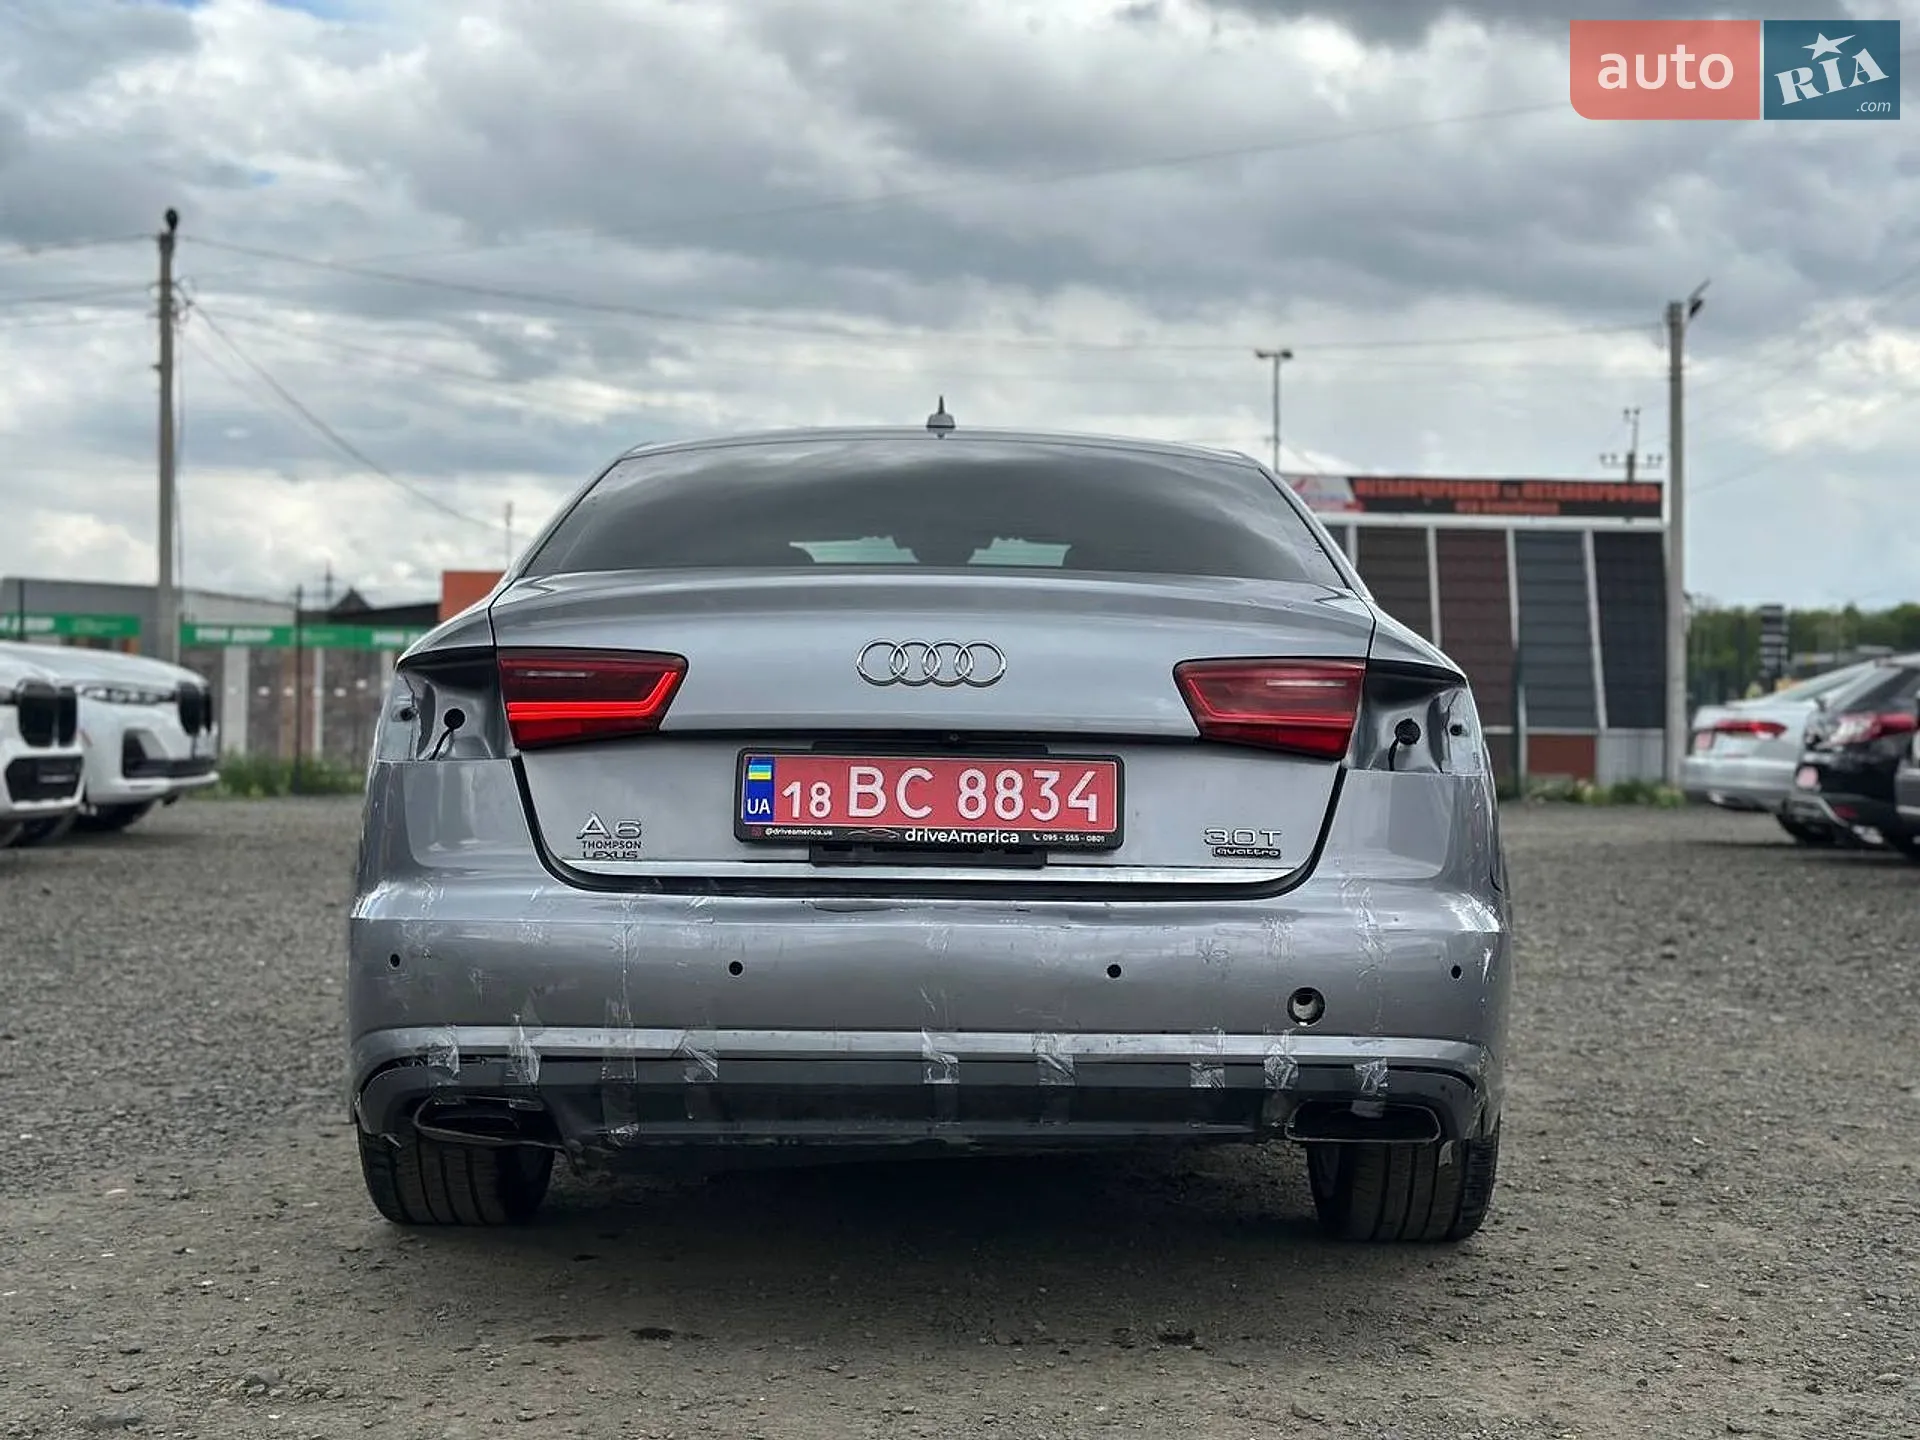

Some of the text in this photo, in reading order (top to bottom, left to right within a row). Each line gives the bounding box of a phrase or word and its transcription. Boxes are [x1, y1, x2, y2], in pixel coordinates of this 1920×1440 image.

[781, 766, 1098, 823] 18 BC 8834
[747, 799, 771, 816] UA
[576, 811, 641, 840] A6
[904, 828, 1020, 844] driveAmerica
[581, 840, 642, 849] THOMPSON
[583, 851, 638, 860] LEXUS
